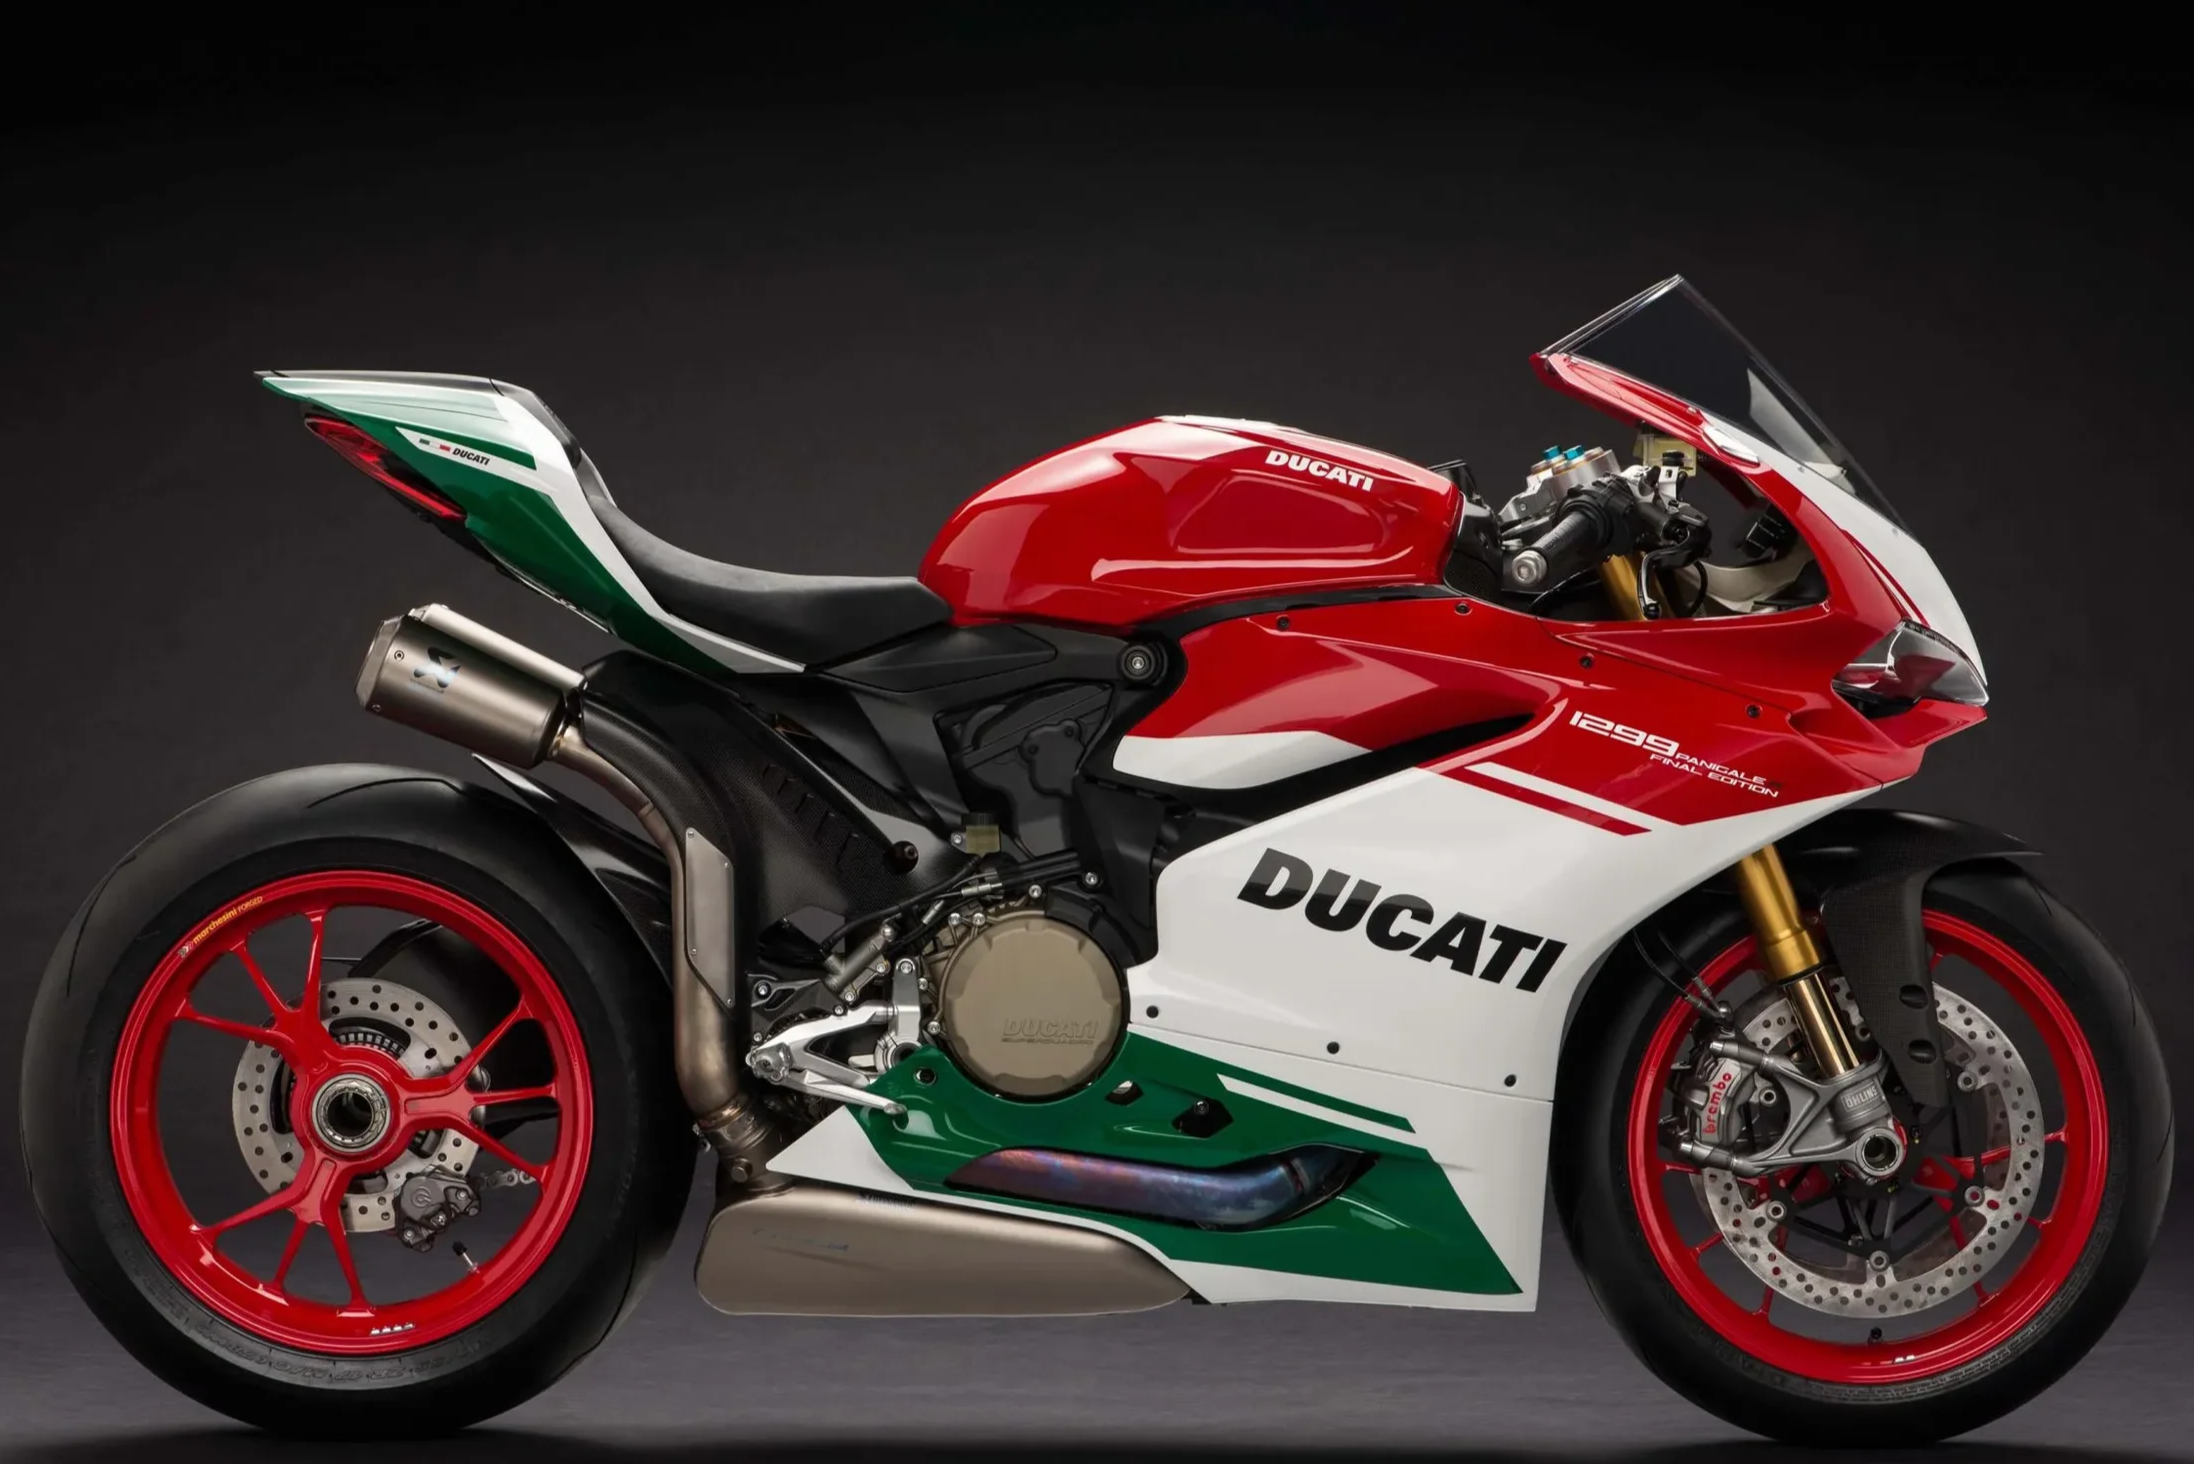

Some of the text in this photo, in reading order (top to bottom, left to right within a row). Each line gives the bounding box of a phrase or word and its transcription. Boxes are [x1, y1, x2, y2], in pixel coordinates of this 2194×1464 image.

[452, 448, 491, 466] DUCATI
[1265, 450, 1374, 492] DUCATI
[1569, 710, 1767, 784] 1299 PANIGALE
[1649, 754, 1779, 798] FINAL EDITION
[193, 896, 263, 944] marchesini FORGED
[1237, 847, 1568, 993] DUCATI
[1003, 1016, 1099, 1038] DUCATI
[1702, 1072, 1732, 1134] brembo
